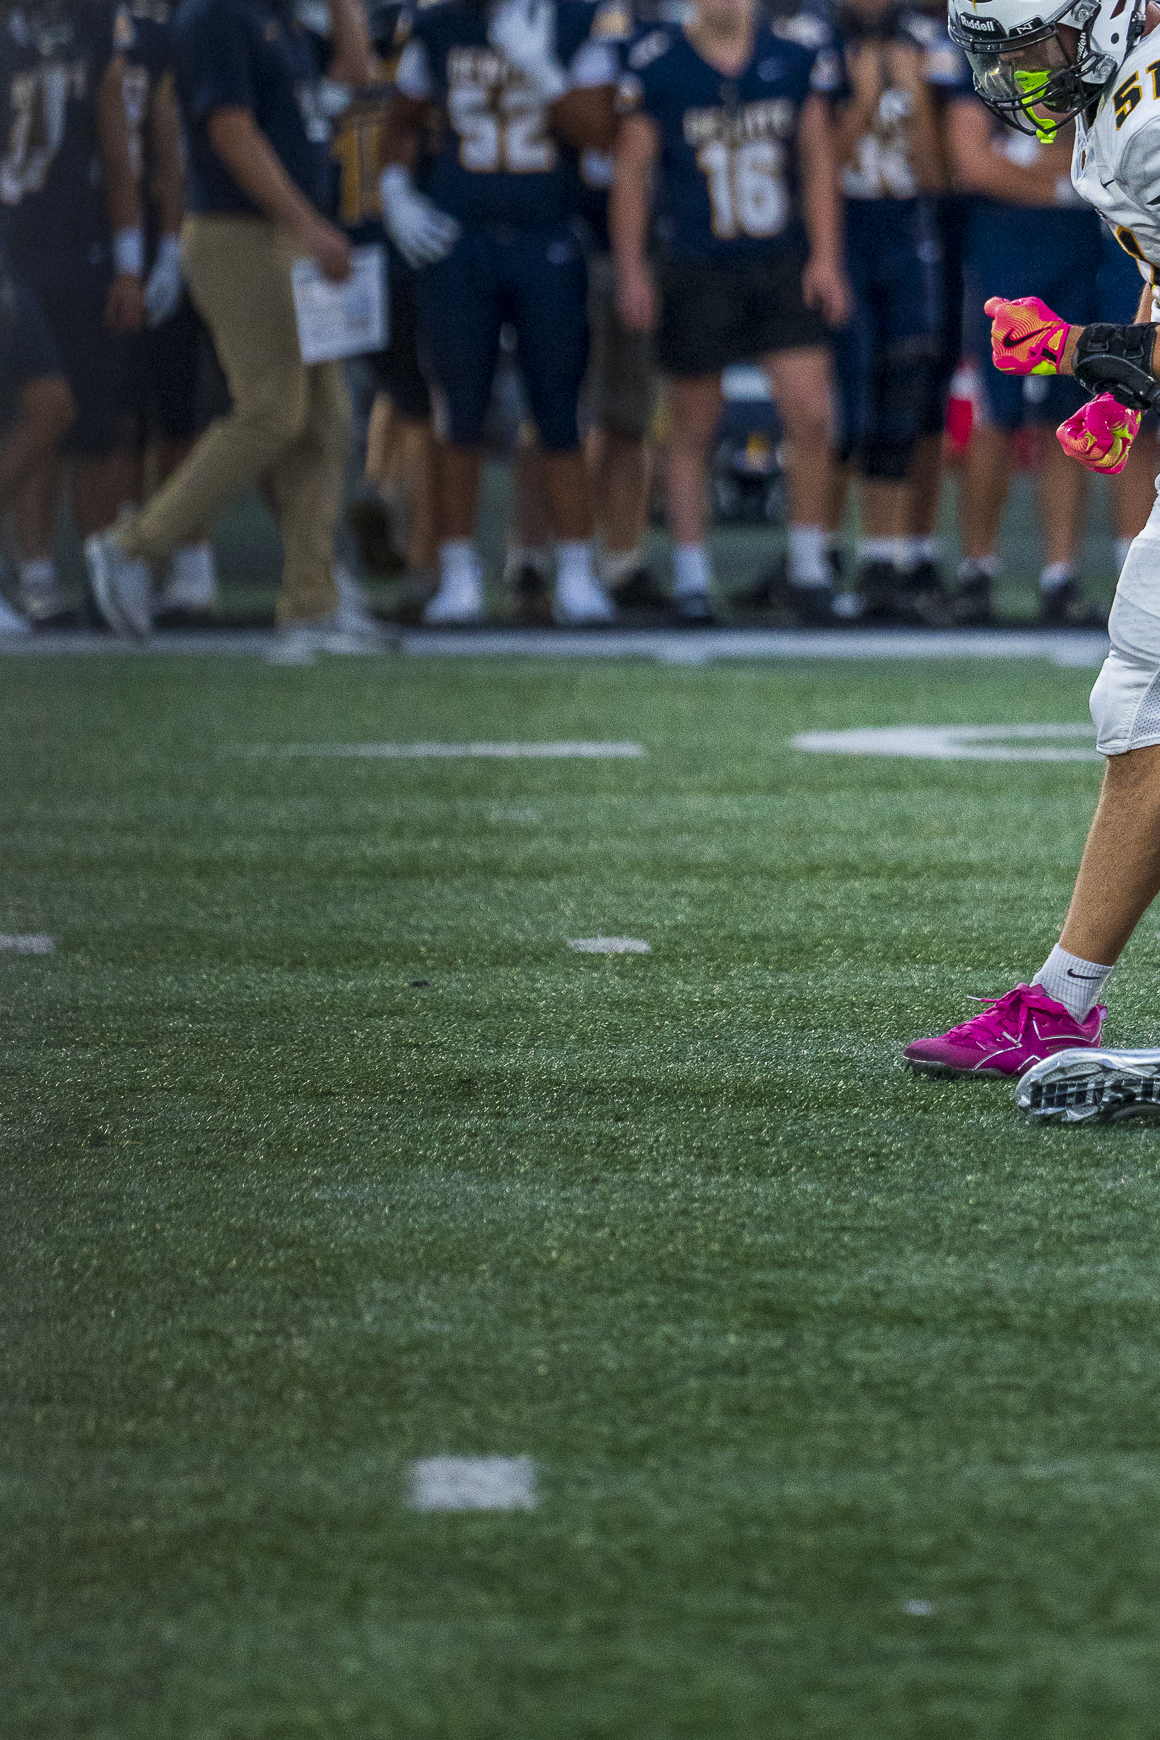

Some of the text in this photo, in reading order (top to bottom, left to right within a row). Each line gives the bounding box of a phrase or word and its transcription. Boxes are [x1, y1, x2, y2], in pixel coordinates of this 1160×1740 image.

[960, 14, 996, 33] Riddell
[449, 88, 556, 174] 52
[695, 136, 791, 239] 16
